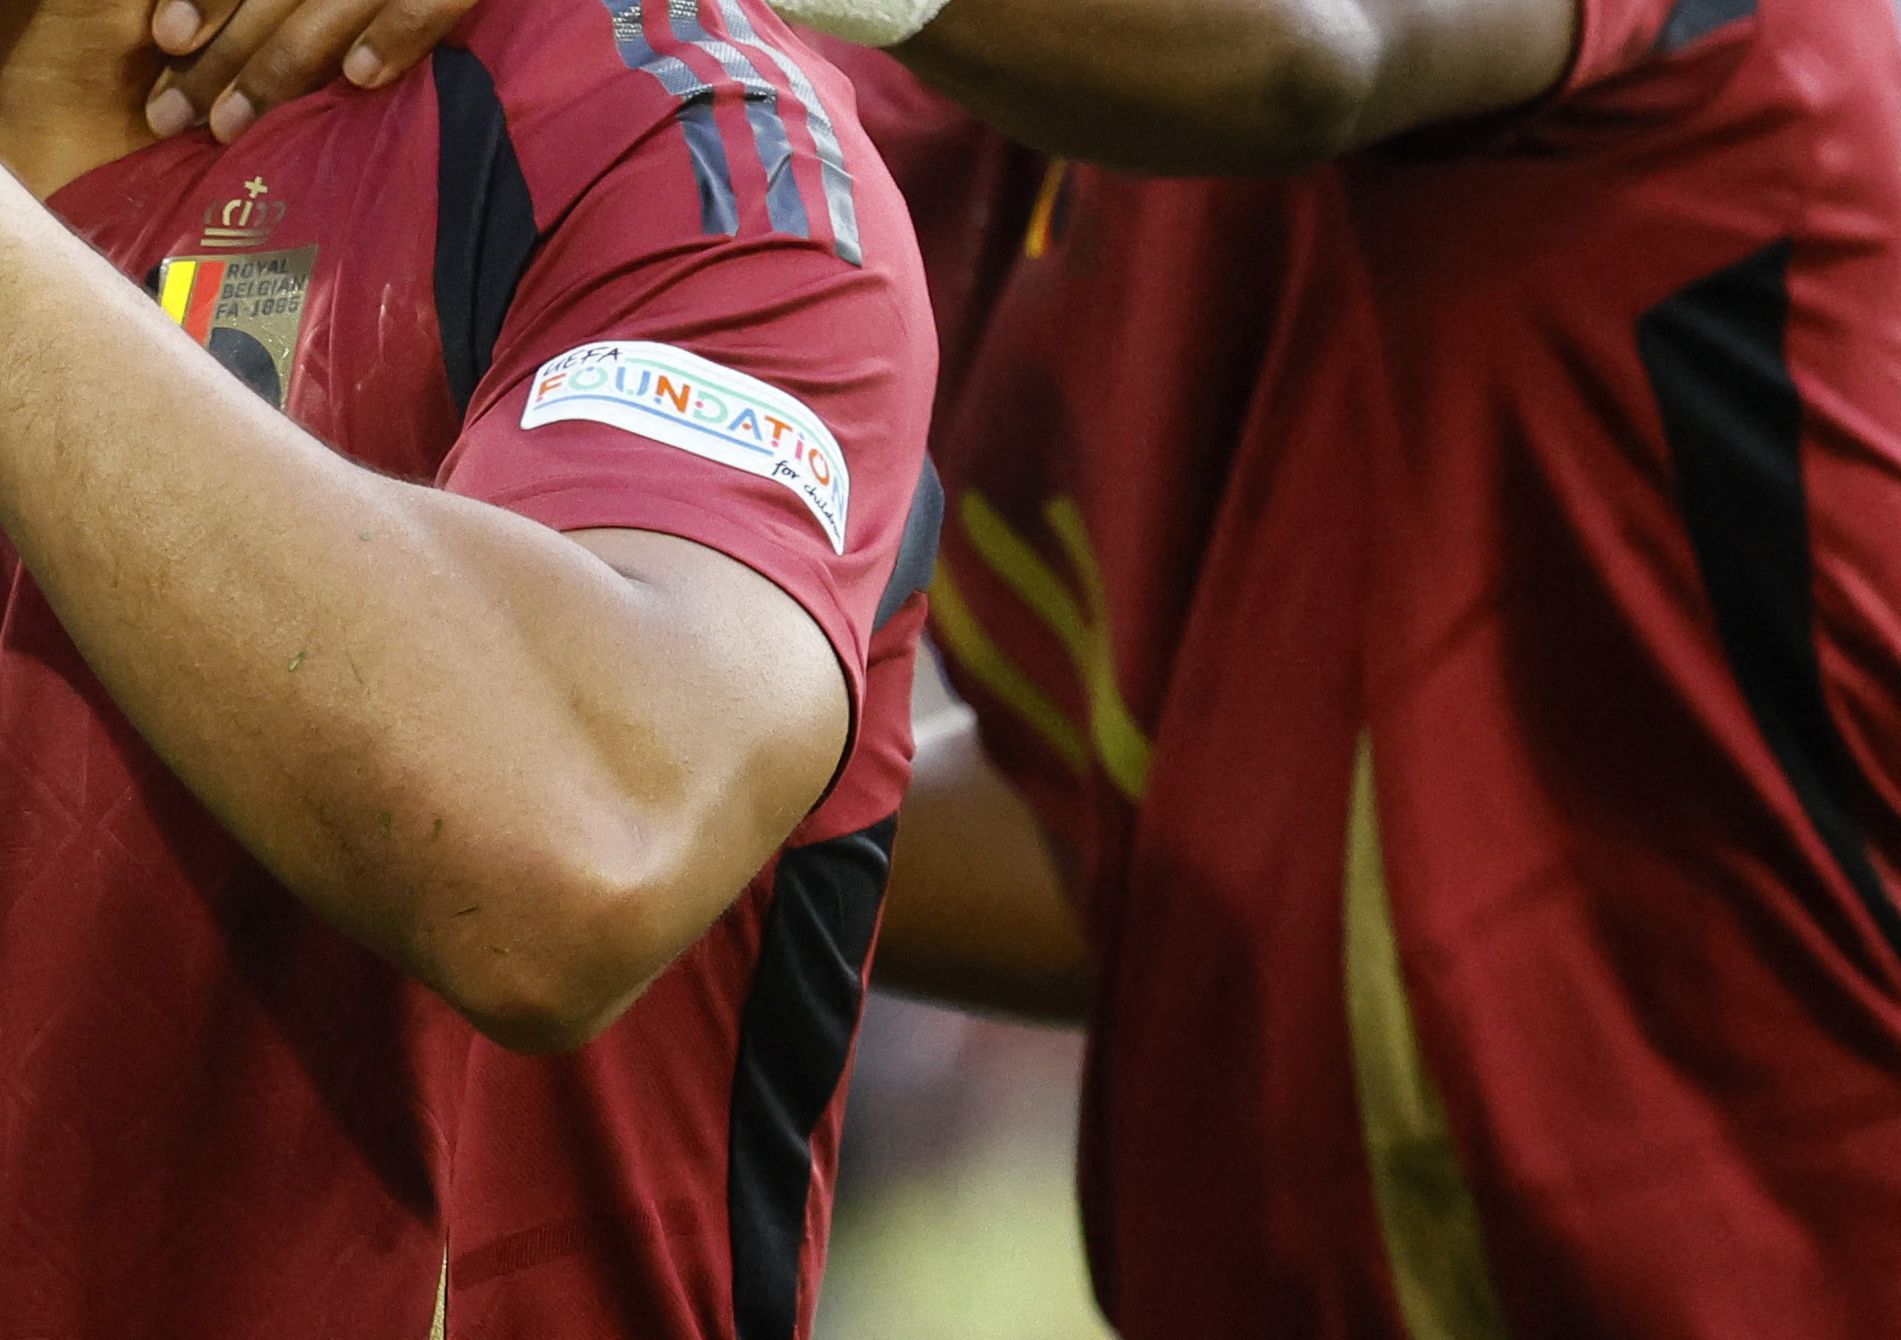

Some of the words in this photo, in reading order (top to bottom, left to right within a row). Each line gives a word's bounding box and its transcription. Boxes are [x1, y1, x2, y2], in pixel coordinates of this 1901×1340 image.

[227, 259, 288, 278] ROYAL
[221, 274, 306, 300] BELGIAN
[216, 301, 238, 320] FA
[543, 346, 623, 376] UEFA
[536, 366, 846, 522] FOUNDATION
[772, 460, 800, 479] for
